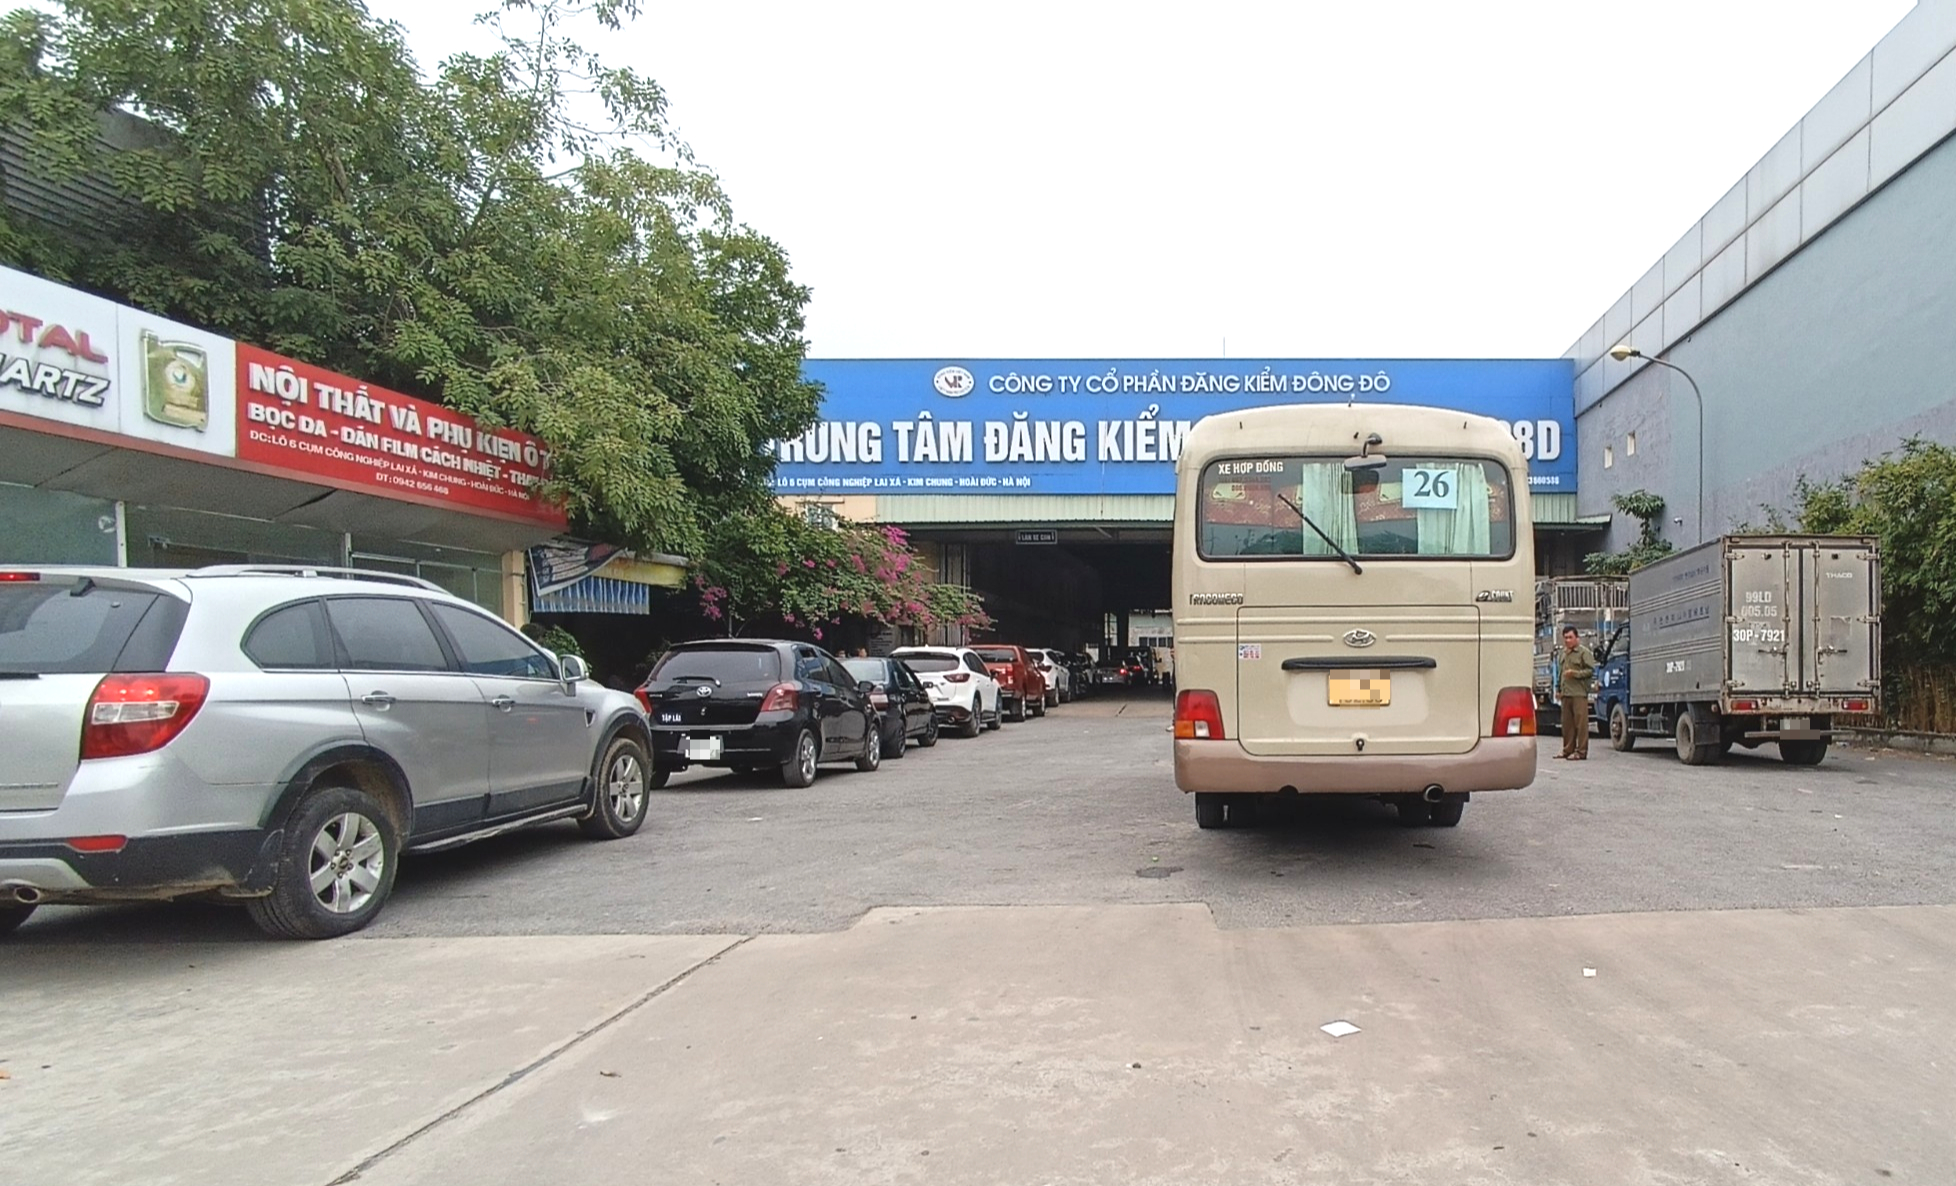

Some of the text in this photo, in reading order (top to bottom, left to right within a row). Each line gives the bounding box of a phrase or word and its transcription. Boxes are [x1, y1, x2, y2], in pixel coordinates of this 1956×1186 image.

[0, 353, 111, 407] ARTZ
[989, 372, 1053, 393] CÔNG
[1058, 375, 1081, 393] TY
[1085, 367, 1119, 393] CỔ
[1123, 369, 1176, 392] PHẦN
[1180, 371, 1240, 392] ĐĂNG
[1244, 366, 1287, 392] KIỂM
[1292, 371, 1354, 392] ĐÔNG
[1358, 370, 1390, 392] ĐÔ
[249, 362, 308, 407] NỘI
[314, 381, 386, 424] THẤT
[388, 404, 422, 436] VÀ
[426, 416, 472, 454] PHỤ
[524, 440, 538, 468] Ô
[764, 421, 882, 462] RUNG
[892, 410, 973, 462] TÂM
[984, 410, 1086, 462] ĐĂNG
[1098, 403, 1191, 461] KIỂM
[248, 402, 295, 431] BỌC
[381, 436, 418, 460] FILM
[420, 445, 461, 470] CÁCH
[463, 459, 501, 481] NHIỆT
[289, 439, 297, 449] 6
[325, 444, 354, 462] CÔNG
[391, 461, 405, 473] LAI
[439, 473, 467, 486] CHUNG
[796, 477, 815, 489] CỤM
[817, 475, 840, 487] CÔNG
[842, 476, 872, 489] NGHIỆP
[874, 478, 888, 487] LAI
[907, 477, 923, 487] KIM
[925, 477, 953, 487] CHUNG
[959, 475, 979, 487] HOÀI
[1002, 475, 1014, 487] HÀ
[1016, 475, 1031, 488] NỘI
[1218, 463, 1231, 475] XE
[1414, 471, 1449, 498] 26
